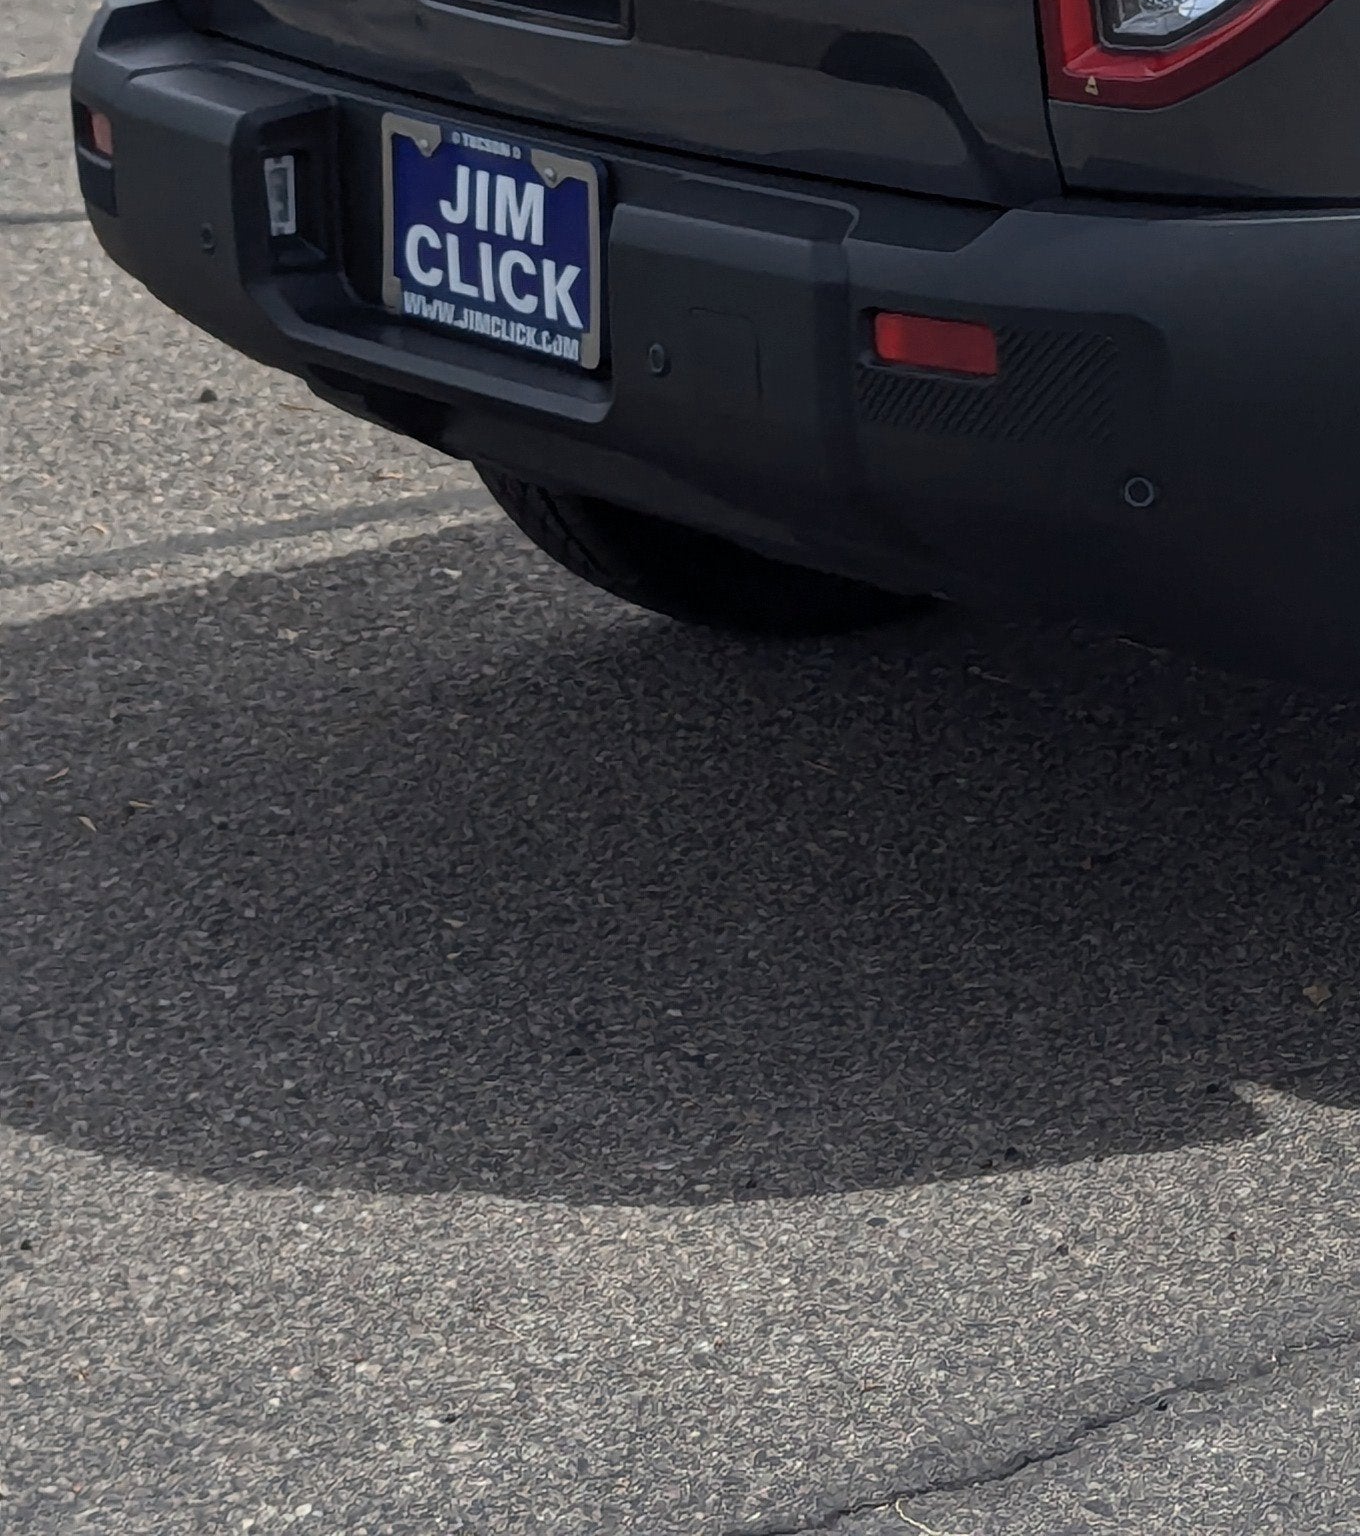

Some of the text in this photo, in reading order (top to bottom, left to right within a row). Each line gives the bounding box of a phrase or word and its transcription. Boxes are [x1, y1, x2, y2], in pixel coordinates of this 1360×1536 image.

[439, 164, 545, 247] JIM
[405, 224, 584, 330] CLICK
[403, 290, 580, 362] WWW.JIMCLICK.COM
